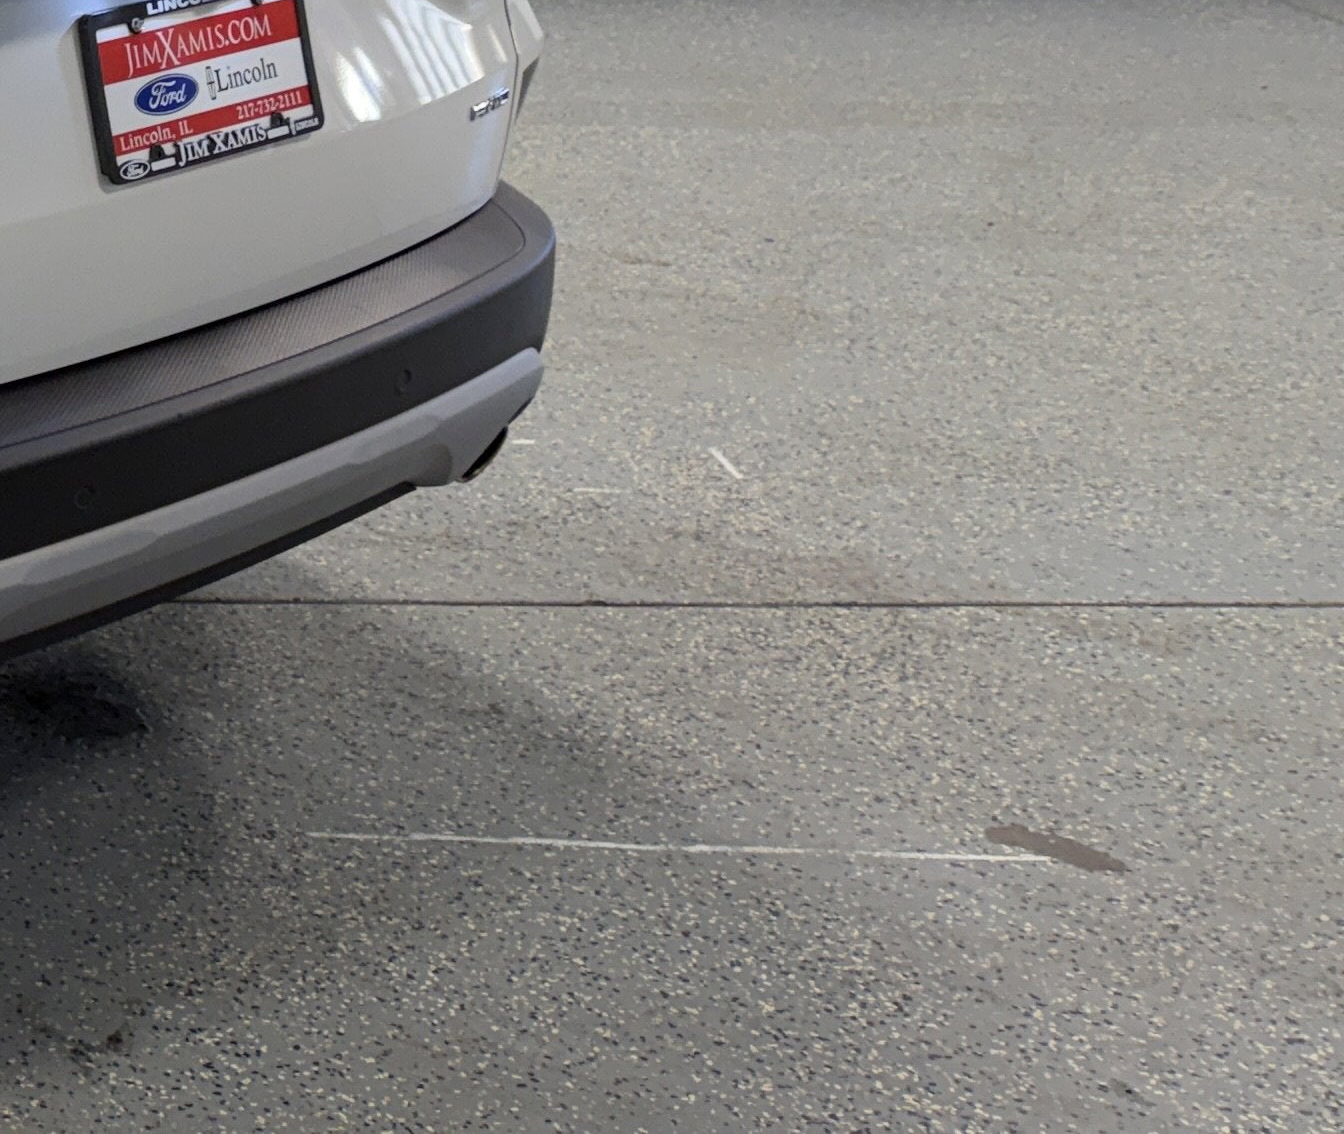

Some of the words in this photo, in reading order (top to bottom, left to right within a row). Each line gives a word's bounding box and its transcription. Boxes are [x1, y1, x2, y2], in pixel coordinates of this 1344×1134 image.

[124, 14, 272, 78] JIMXAMIS.COM
[214, 58, 278, 92] Lincoln
[119, 125, 176, 151] Lincoln,
[179, 120, 193, 136] IL
[178, 140, 210, 166] JIM
[212, 125, 267, 153] XAMIS
